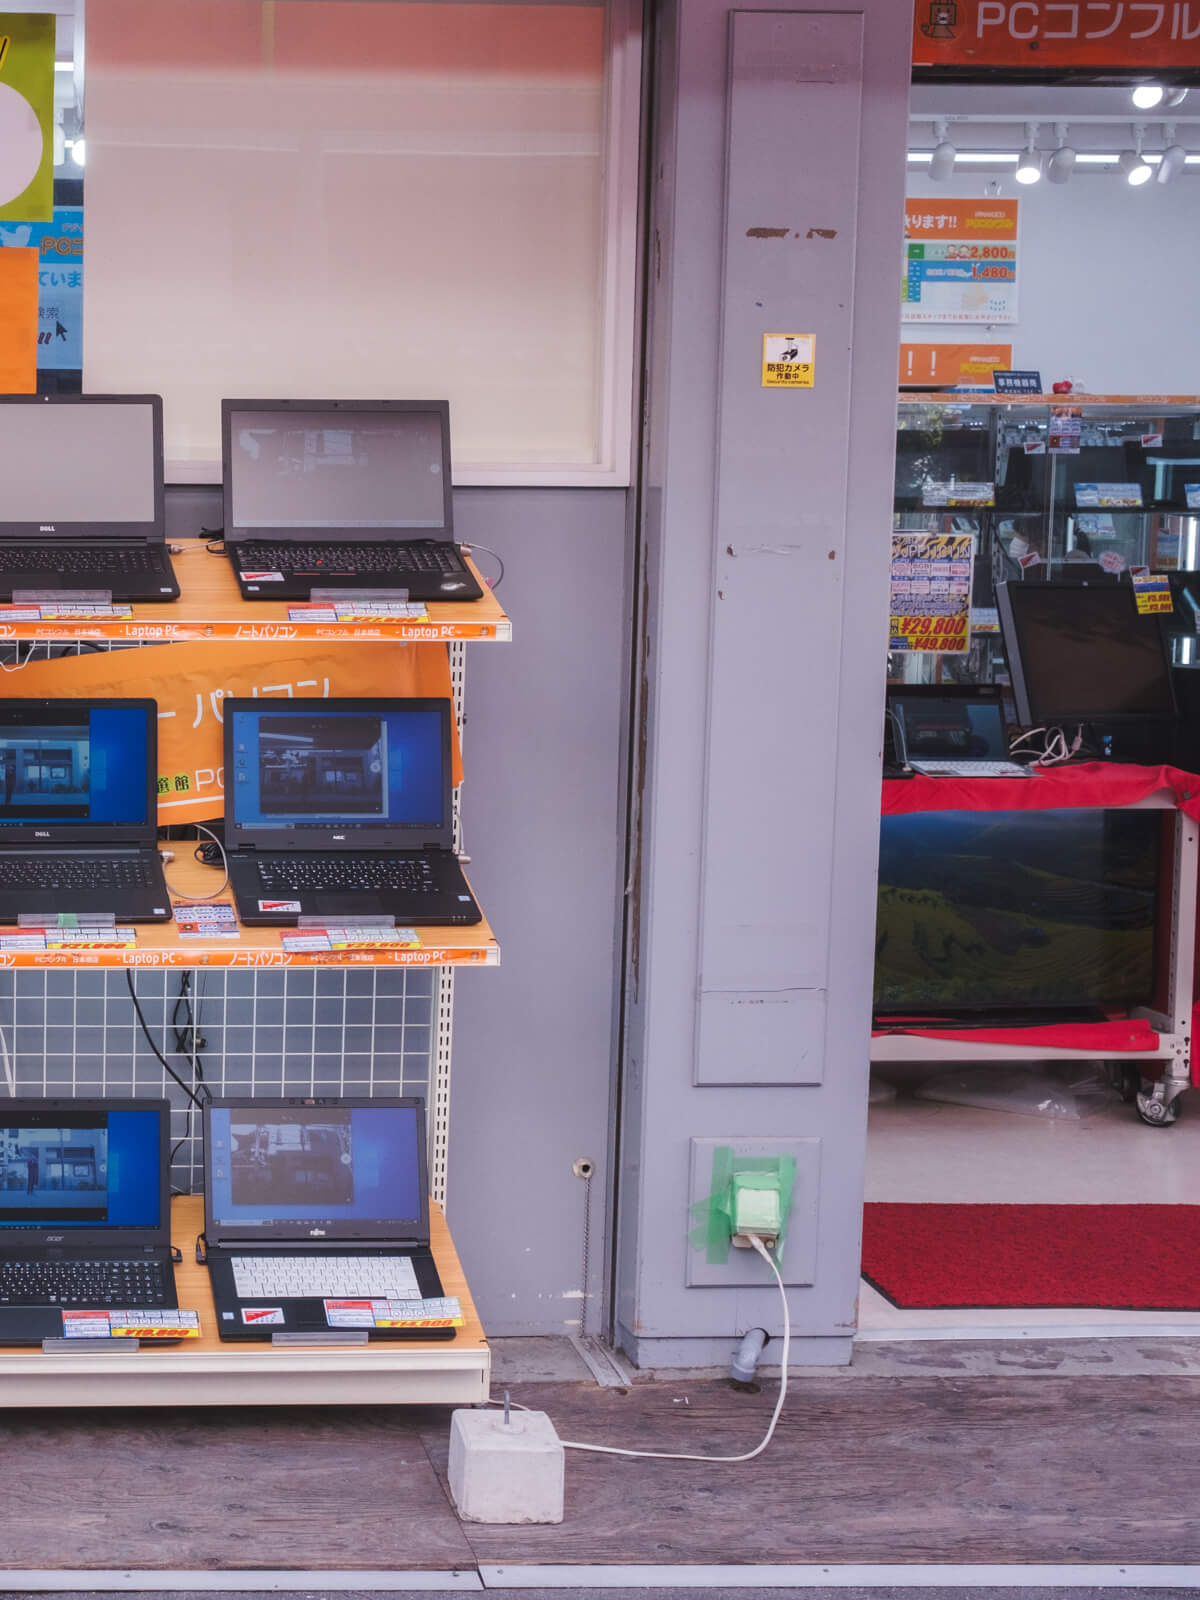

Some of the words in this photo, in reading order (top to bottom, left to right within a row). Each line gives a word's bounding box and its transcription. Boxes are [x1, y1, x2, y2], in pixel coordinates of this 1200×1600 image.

[976, 2, 1200, 39] PCコンフル
[767, 363, 809, 373] 防犯カメラ
[125, 625, 162, 637] Laptop
[165, 625, 179, 636] PC
[234, 625, 298, 639] ノートパソコン
[401, 625, 439, 638] Laptop
[441, 626, 456, 637] PC
[901, 617, 967, 635] ¥29,800
[122, 952, 160, 965] Laptop
[162, 952, 176, 963] PC
[229, 951, 293, 966] ノートパソコン
[394, 951, 431, 964] Laptop
[432, 951, 446, 962] PC
